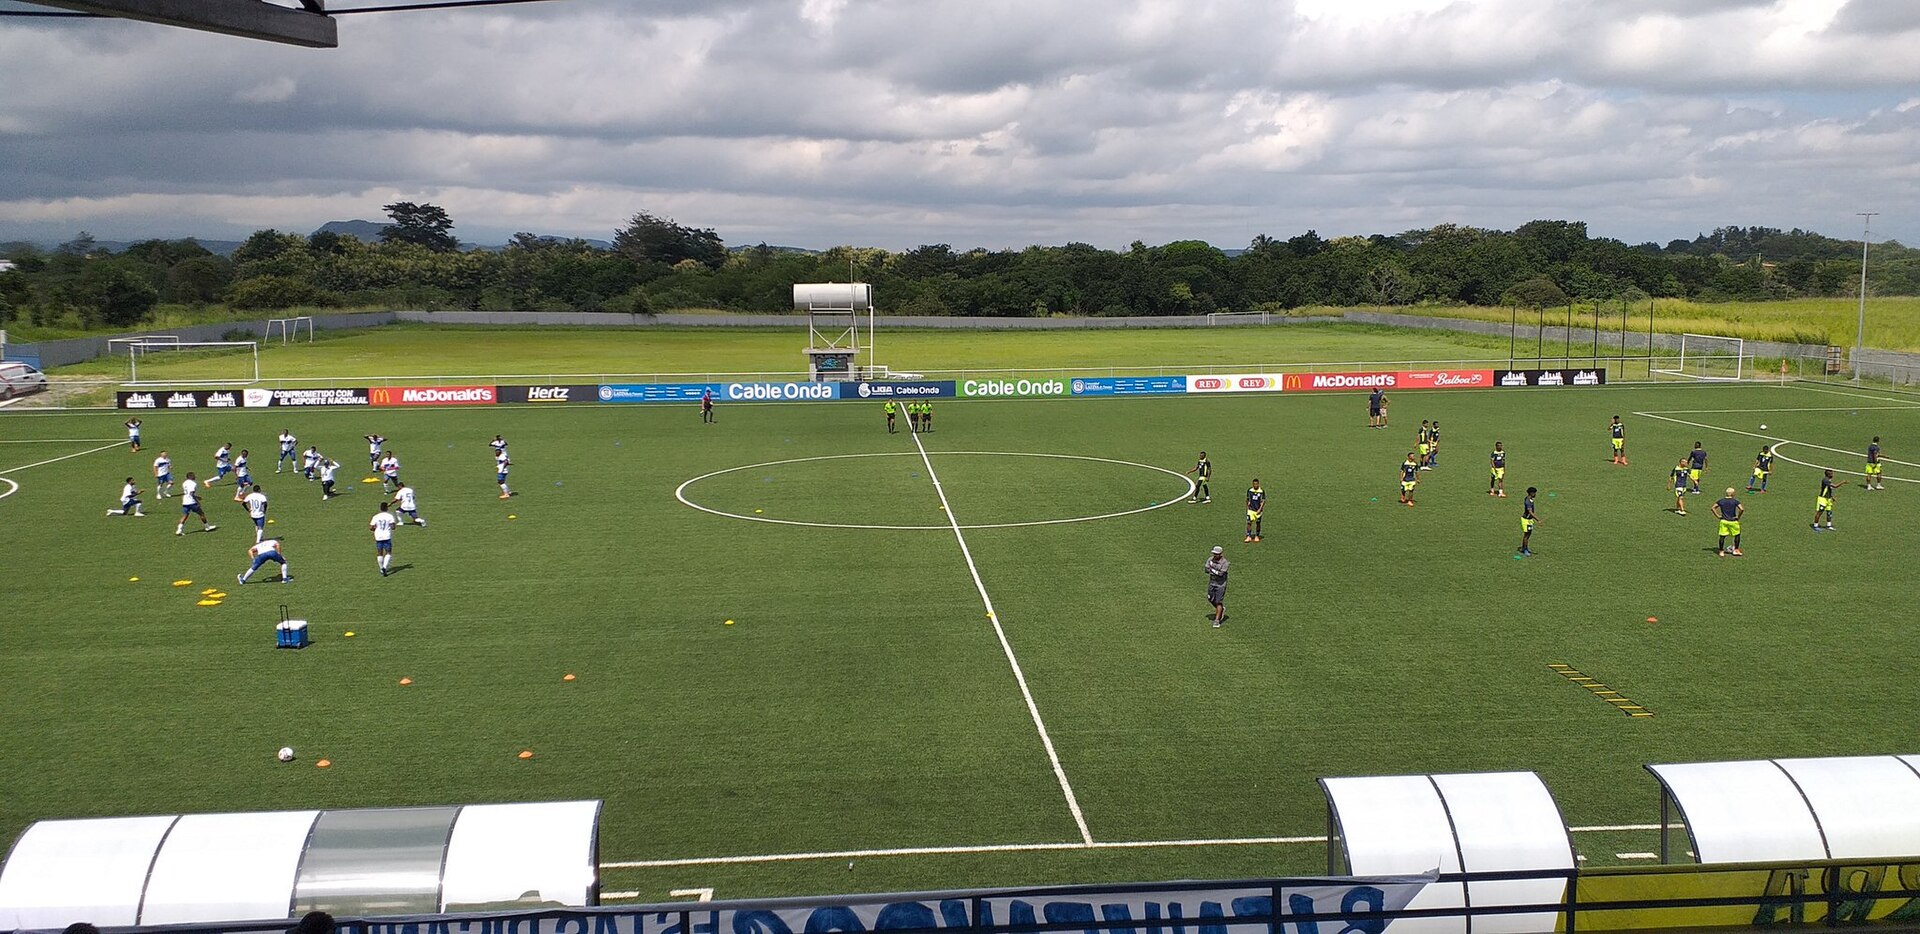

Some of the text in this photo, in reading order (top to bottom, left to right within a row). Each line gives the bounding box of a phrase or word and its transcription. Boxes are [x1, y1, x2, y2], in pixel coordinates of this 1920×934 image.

[1199, 380, 1217, 388] REY
[1243, 379, 1261, 387] REY
[1313, 374, 1395, 388] McDonald's
[1434, 373, 1470, 386] Balboa
[274, 389, 354, 398] COMPROMETIDO CON
[528, 386, 569, 399] Hertz
[729, 383, 782, 399] Cable
[784, 383, 832, 399] Onda
[896, 386, 940, 395] Cable Onda
[964, 379, 1063, 396] Cable Onda
[290, 397, 327, 405] DEPORTE
[402, 388, 492, 402] McDonald's
